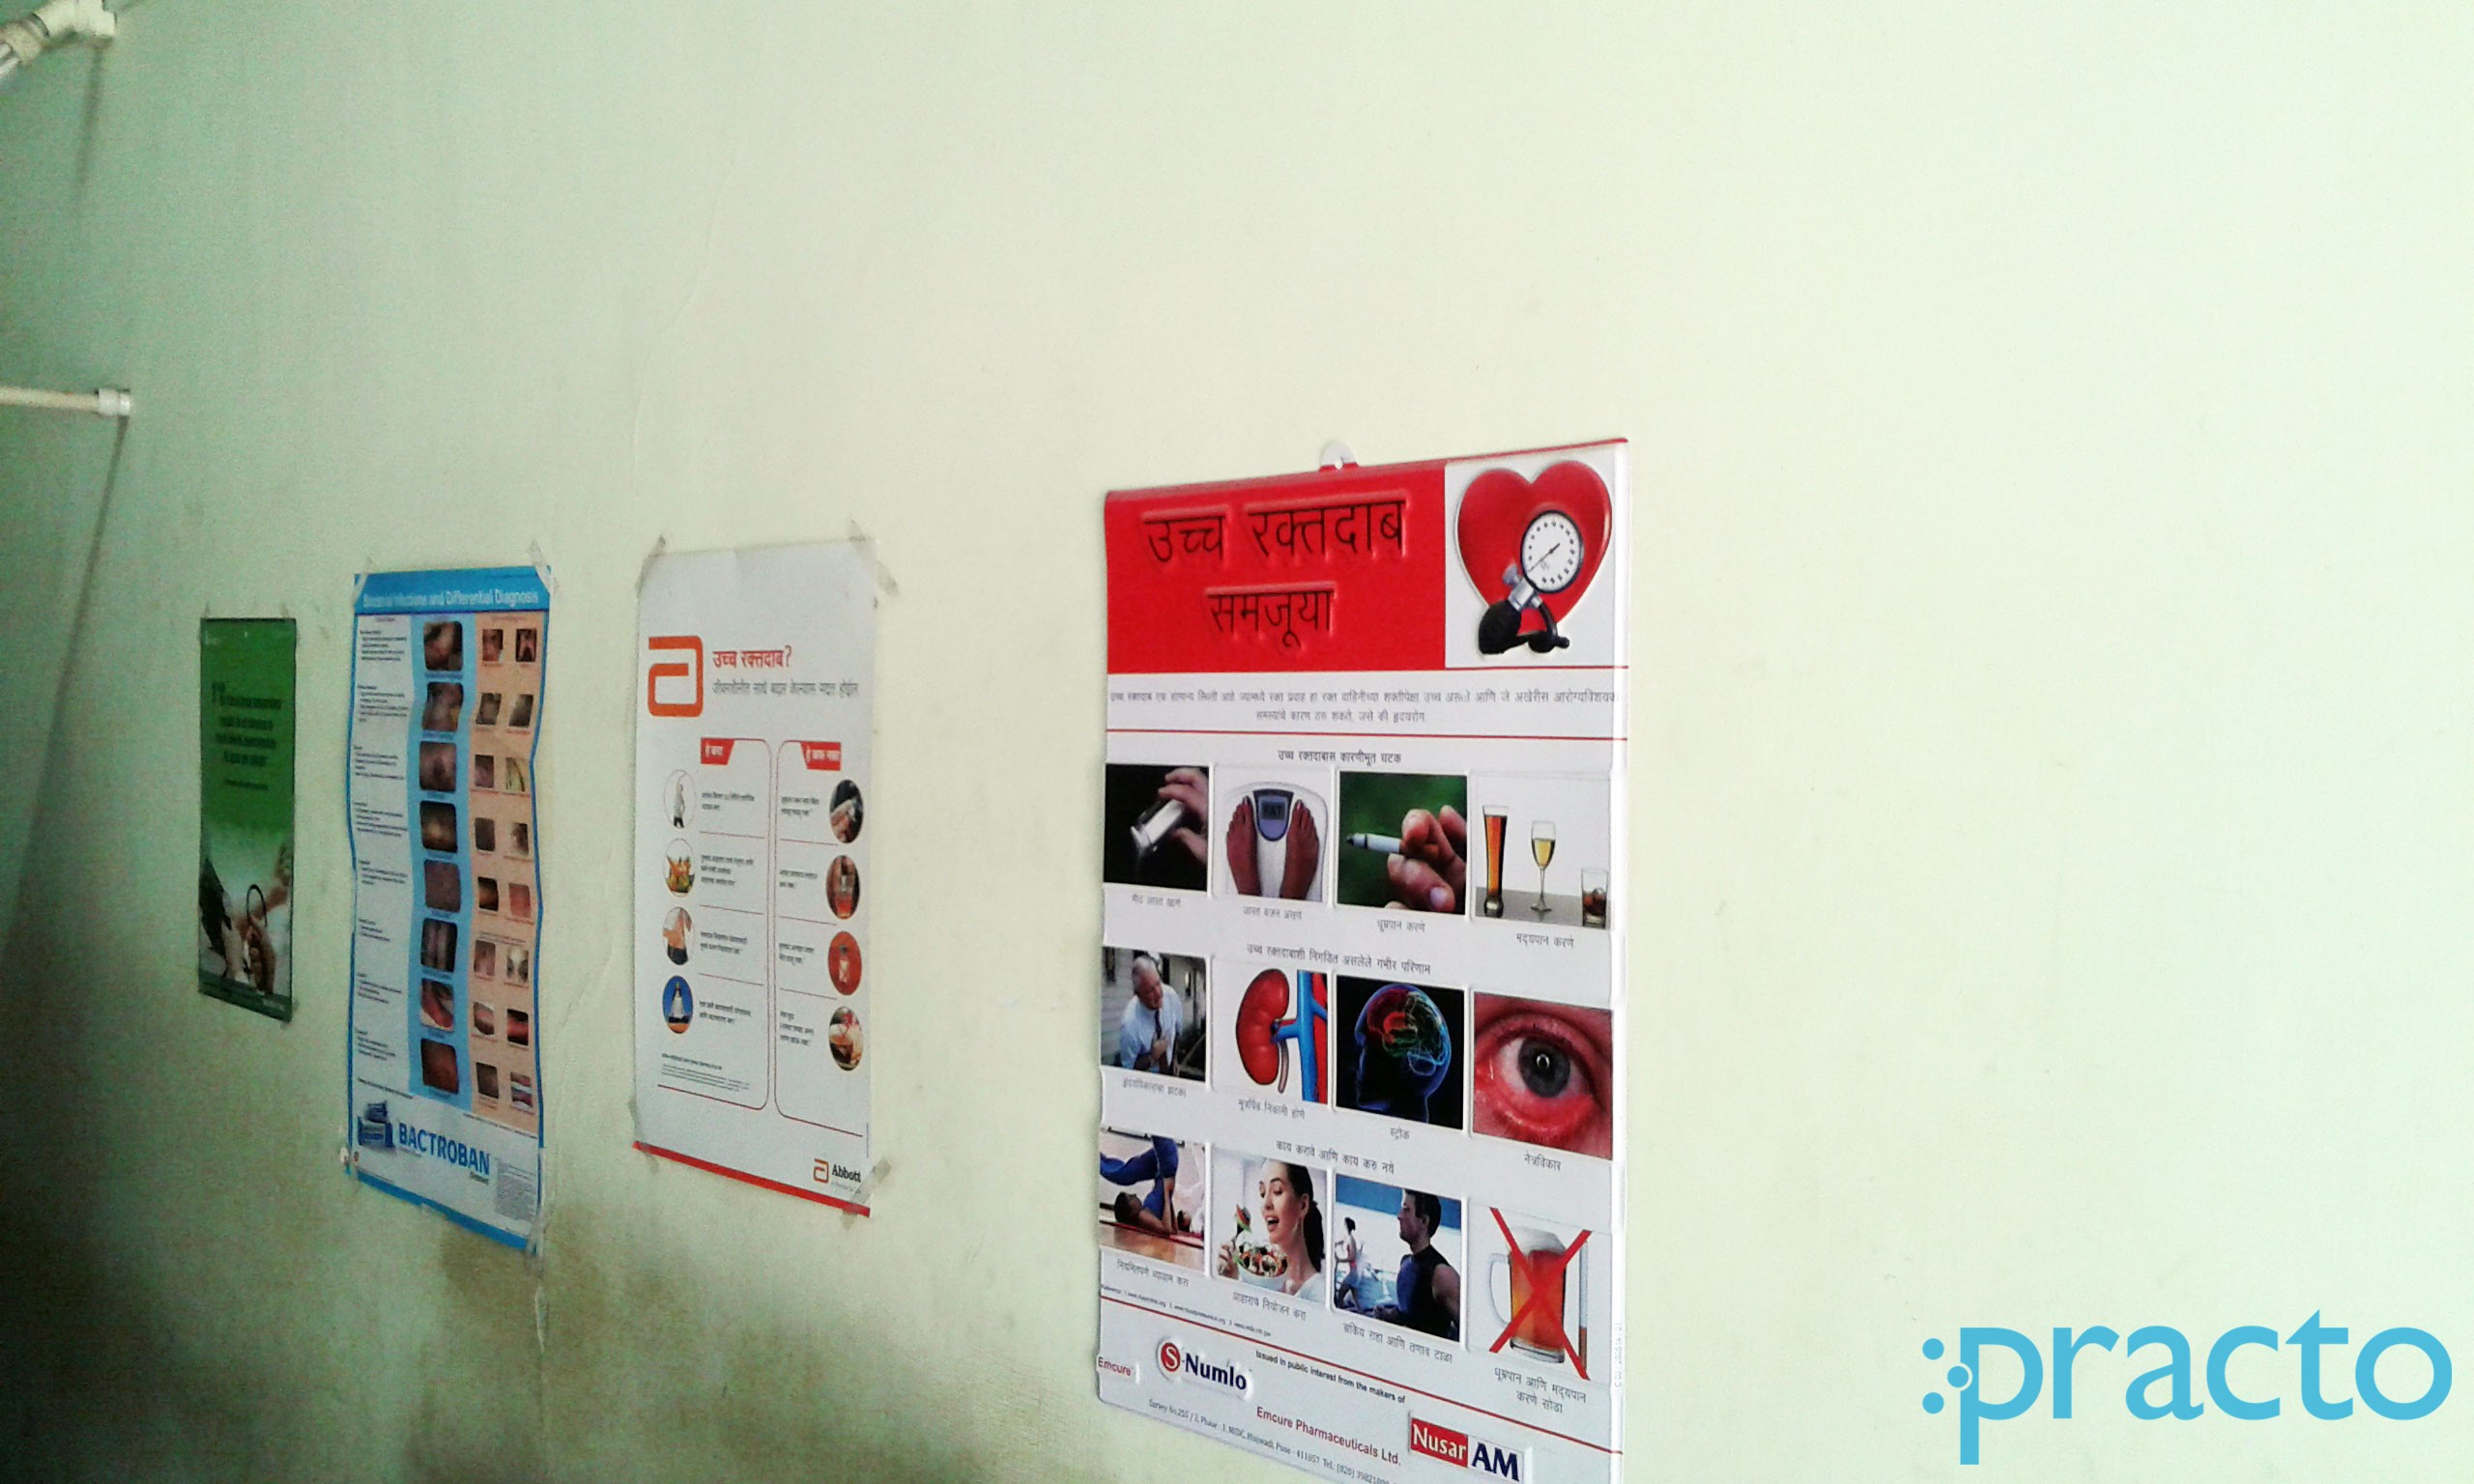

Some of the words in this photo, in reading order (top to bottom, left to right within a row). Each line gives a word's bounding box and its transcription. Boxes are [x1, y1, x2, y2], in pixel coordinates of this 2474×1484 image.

[1144, 513, 1226, 562] उच्च
[1248, 499, 1406, 557] रक्तदाब
[446, 588, 492, 606] Differential
[495, 588, 538, 608] Diagnosis
[1208, 588, 1335, 648] समजूया
[398, 1122, 492, 1176] BACTROBAN
[832, 1163, 862, 1184] Abbott
[1098, 1356, 1132, 1377] Emcure
[1256, 1350, 1278, 1365] Issued
[1280, 1357, 1286, 1367] in
[1287, 1359, 1308, 1375] public
[1309, 1366, 1337, 1383] interest
[1338, 1375, 1354, 1388] from
[1356, 1380, 1367, 1393] the
[1368, 1385, 1395, 1402] makers
[1397, 1393, 1406, 1405] of
[1256, 1406, 1293, 1430] Emcure
[1295, 1418, 1379, 1459] Pharmaceuticals
[1381, 1448, 1401, 1467] Ltd.
[1412, 1423, 1467, 1461] Nusar
[1471, 1442, 1520, 1483] AM
